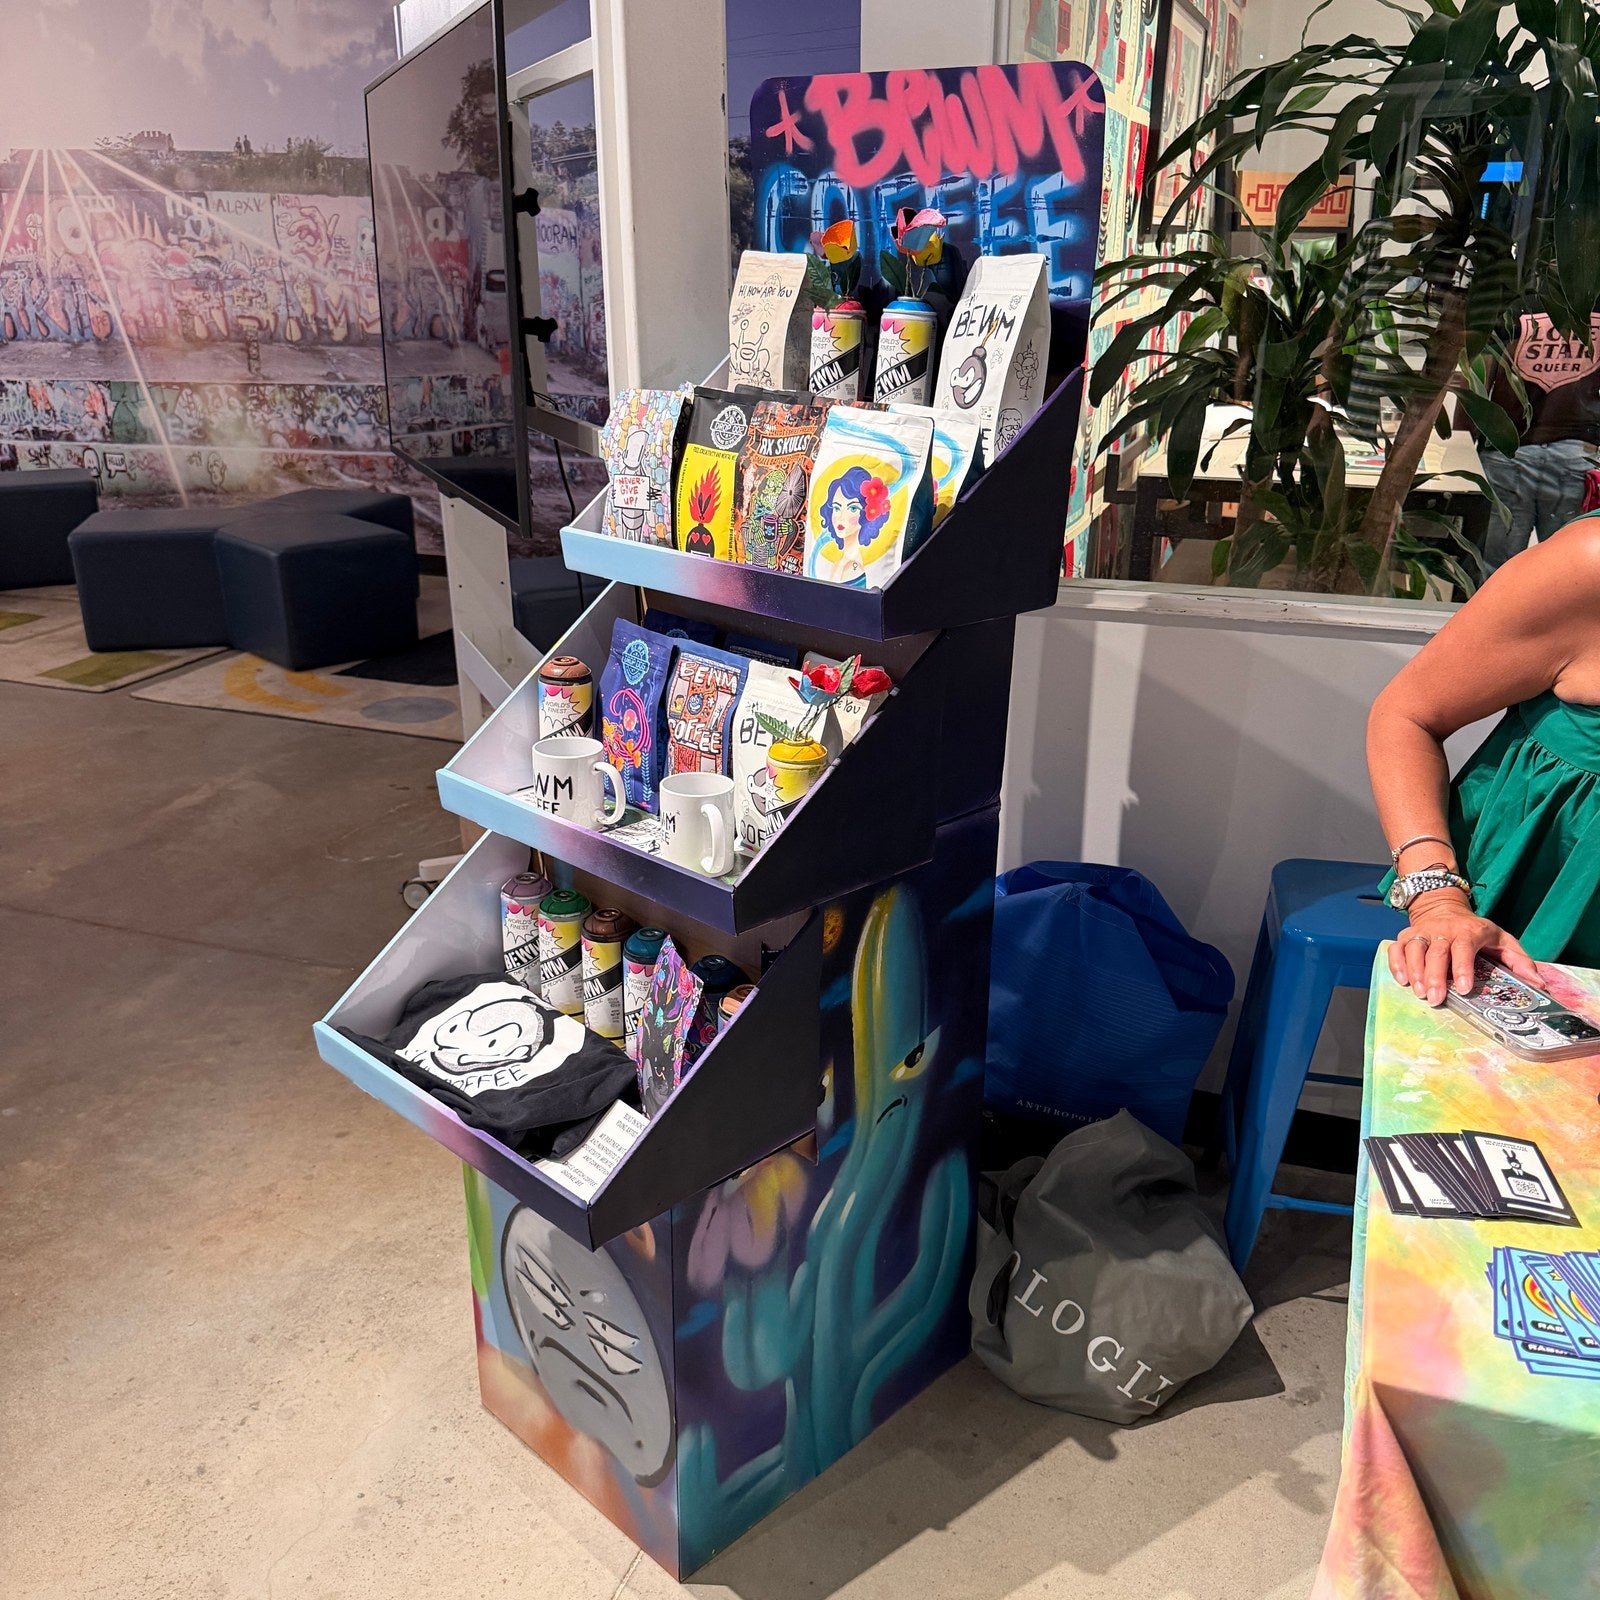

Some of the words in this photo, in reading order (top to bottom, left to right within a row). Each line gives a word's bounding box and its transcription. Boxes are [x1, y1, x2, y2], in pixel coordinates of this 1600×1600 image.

[537, 224, 577, 250] OORAH
[777, 286, 793, 297] YOU
[953, 303, 1016, 342] BEWM
[1530, 325, 1600, 342] LOE
[809, 360, 845, 394] EWM
[1532, 363, 1581, 373] QUEER
[875, 363, 912, 401] EWM
[775, 434, 811, 455] SKULLS
[618, 477, 641, 485] NEVER
[620, 484, 639, 494] GIVE
[624, 496, 638, 507] UP!
[844, 700, 861, 715] YOU
[668, 717, 722, 754] COFFEE
[534, 772, 573, 800] WM
[740, 819, 767, 848] COF
[508, 918, 533, 926] WORLD'S
[510, 923, 530, 931] FINEST
[541, 956, 570, 981] EWM
[1016, 1099, 1104, 1123] ANTHROPOLO
